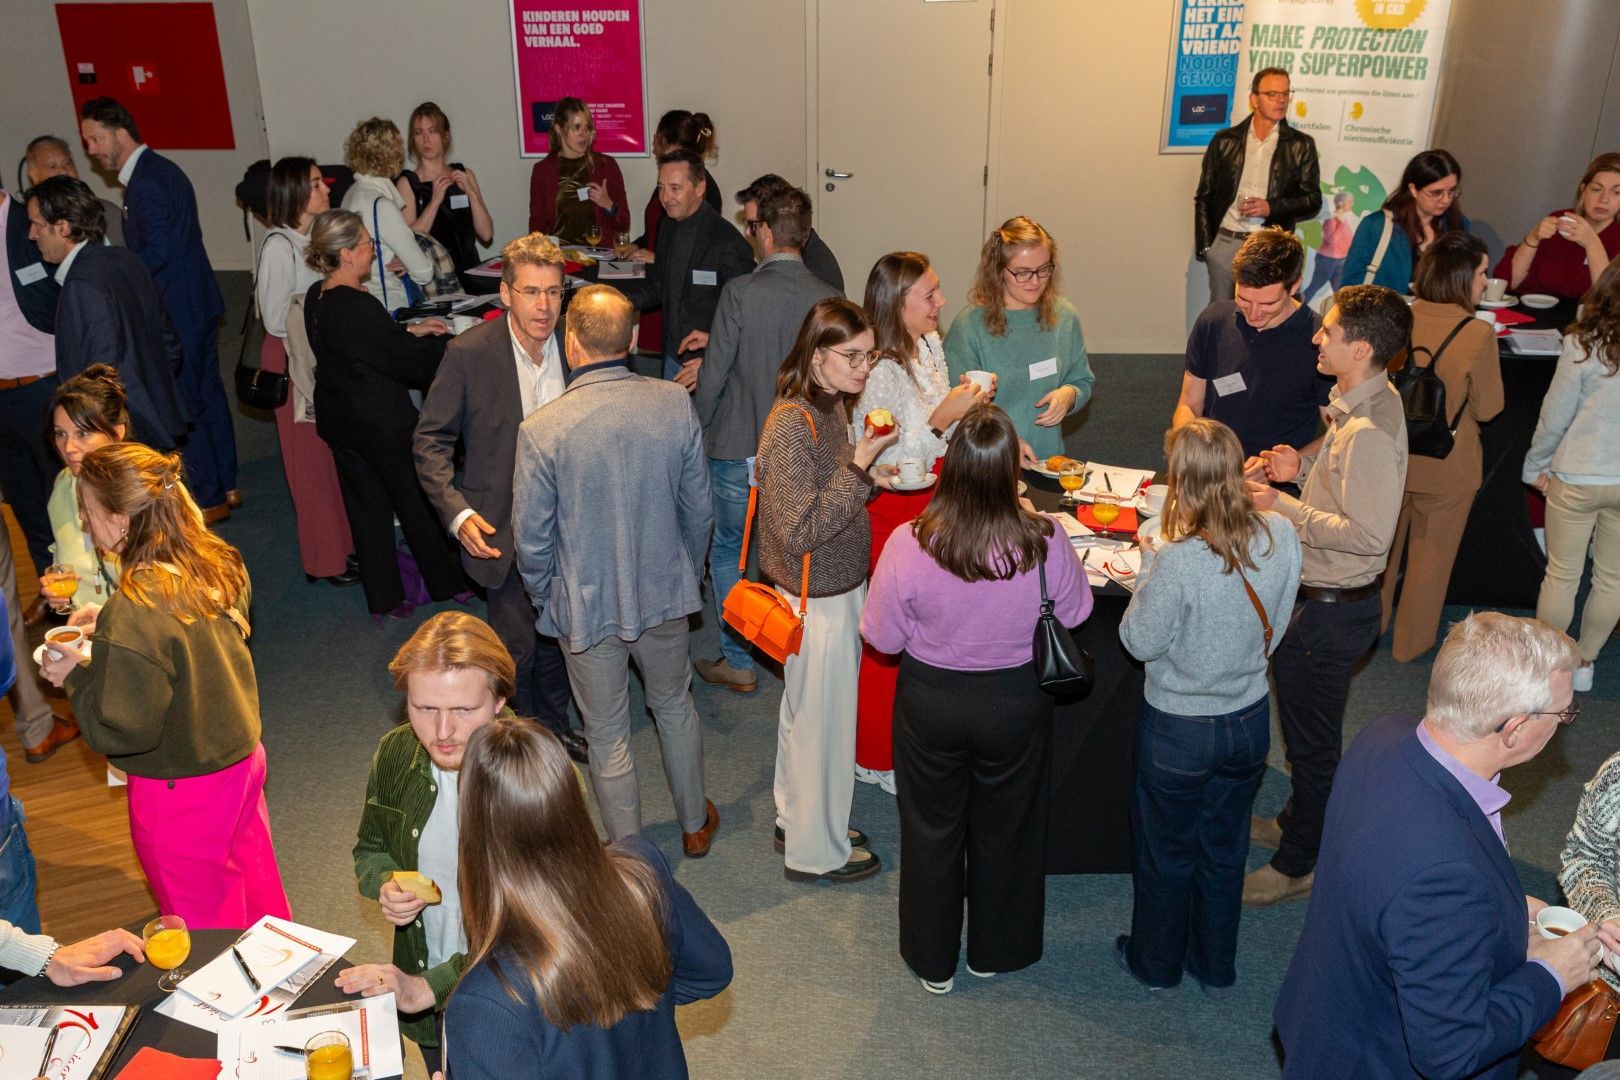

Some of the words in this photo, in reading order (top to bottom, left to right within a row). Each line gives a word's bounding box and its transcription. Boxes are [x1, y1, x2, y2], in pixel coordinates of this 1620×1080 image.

[523, 10, 579, 22] KINDEREN
[582, 10, 630, 22] HOUDEN
[1185, 8, 1214, 22] HET
[523, 23, 547, 35] VAN
[550, 23, 571, 35] EEN
[573, 23, 604, 35] GOED
[1183, 24, 1219, 39] NIET
[524, 36, 580, 47] VERHAAL.
[1250, 24, 1305, 49] MAKE
[1310, 26, 1428, 54] PROTECTION
[1182, 40, 1240, 55] VRIEND
[1180, 55, 1231, 71] NODIG
[1248, 50, 1295, 76] YOUR
[1300, 53, 1428, 80] SUPERPOWER
[1344, 123, 1391, 135] Chronische
